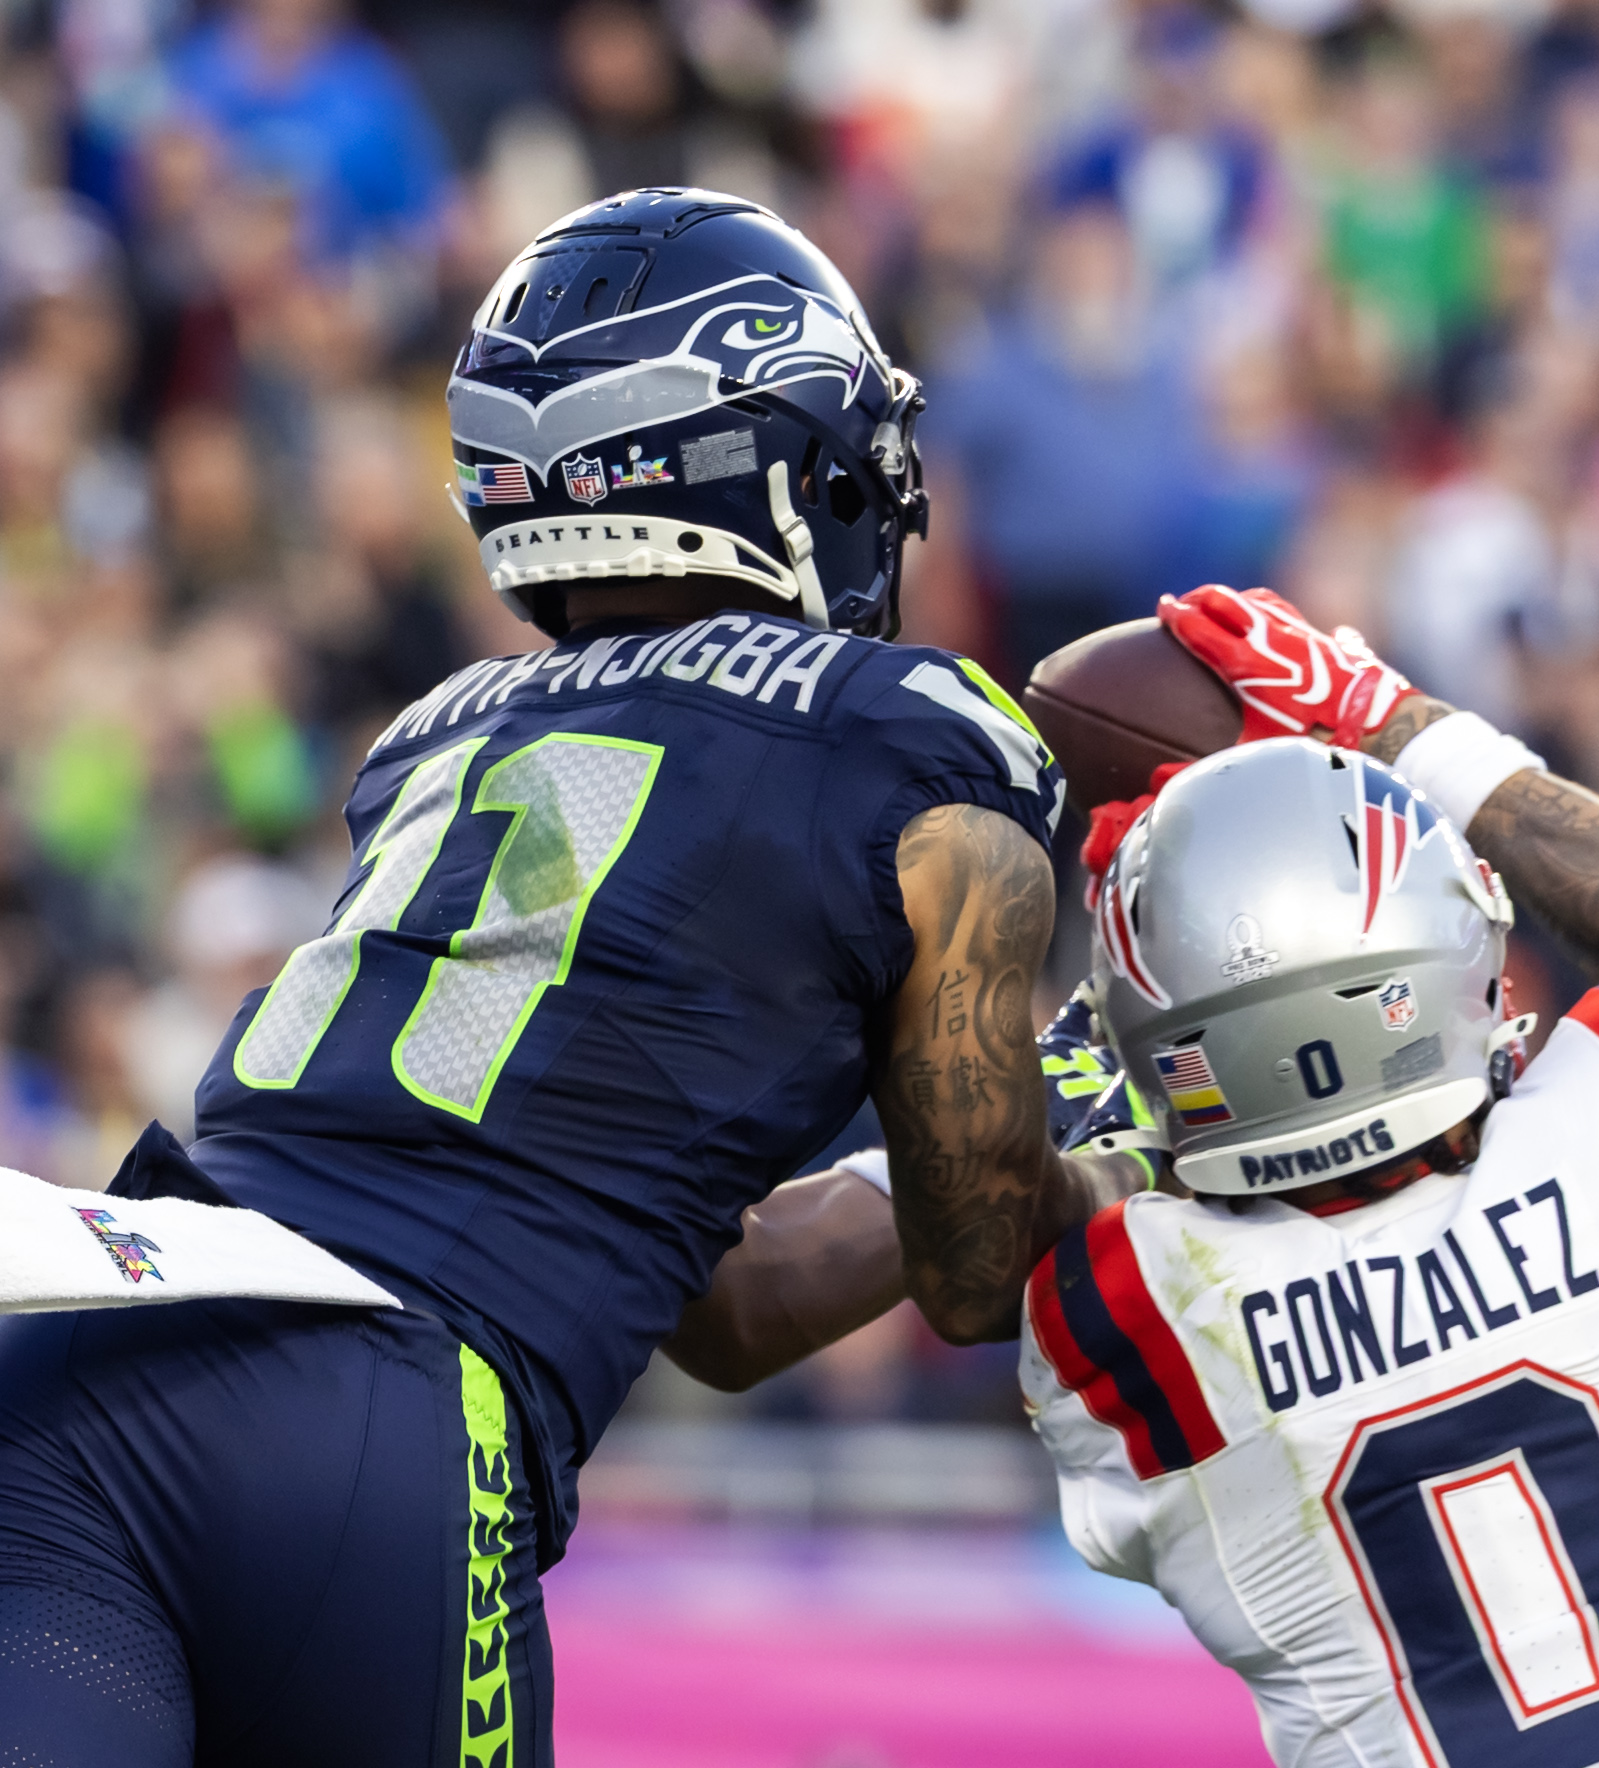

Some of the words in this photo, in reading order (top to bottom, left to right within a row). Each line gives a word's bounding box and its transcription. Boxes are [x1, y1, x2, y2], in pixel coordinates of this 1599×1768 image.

[571, 476, 603, 498] NFL
[495, 526, 649, 552] SEATTLE
[366, 614, 848, 757] MITH-NJIGBA
[233, 731, 665, 1124] 11
[925, 968, 970, 1039] 信
[1295, 1039, 1344, 1100] 0
[1239, 1118, 1395, 1188] PATRIOTS
